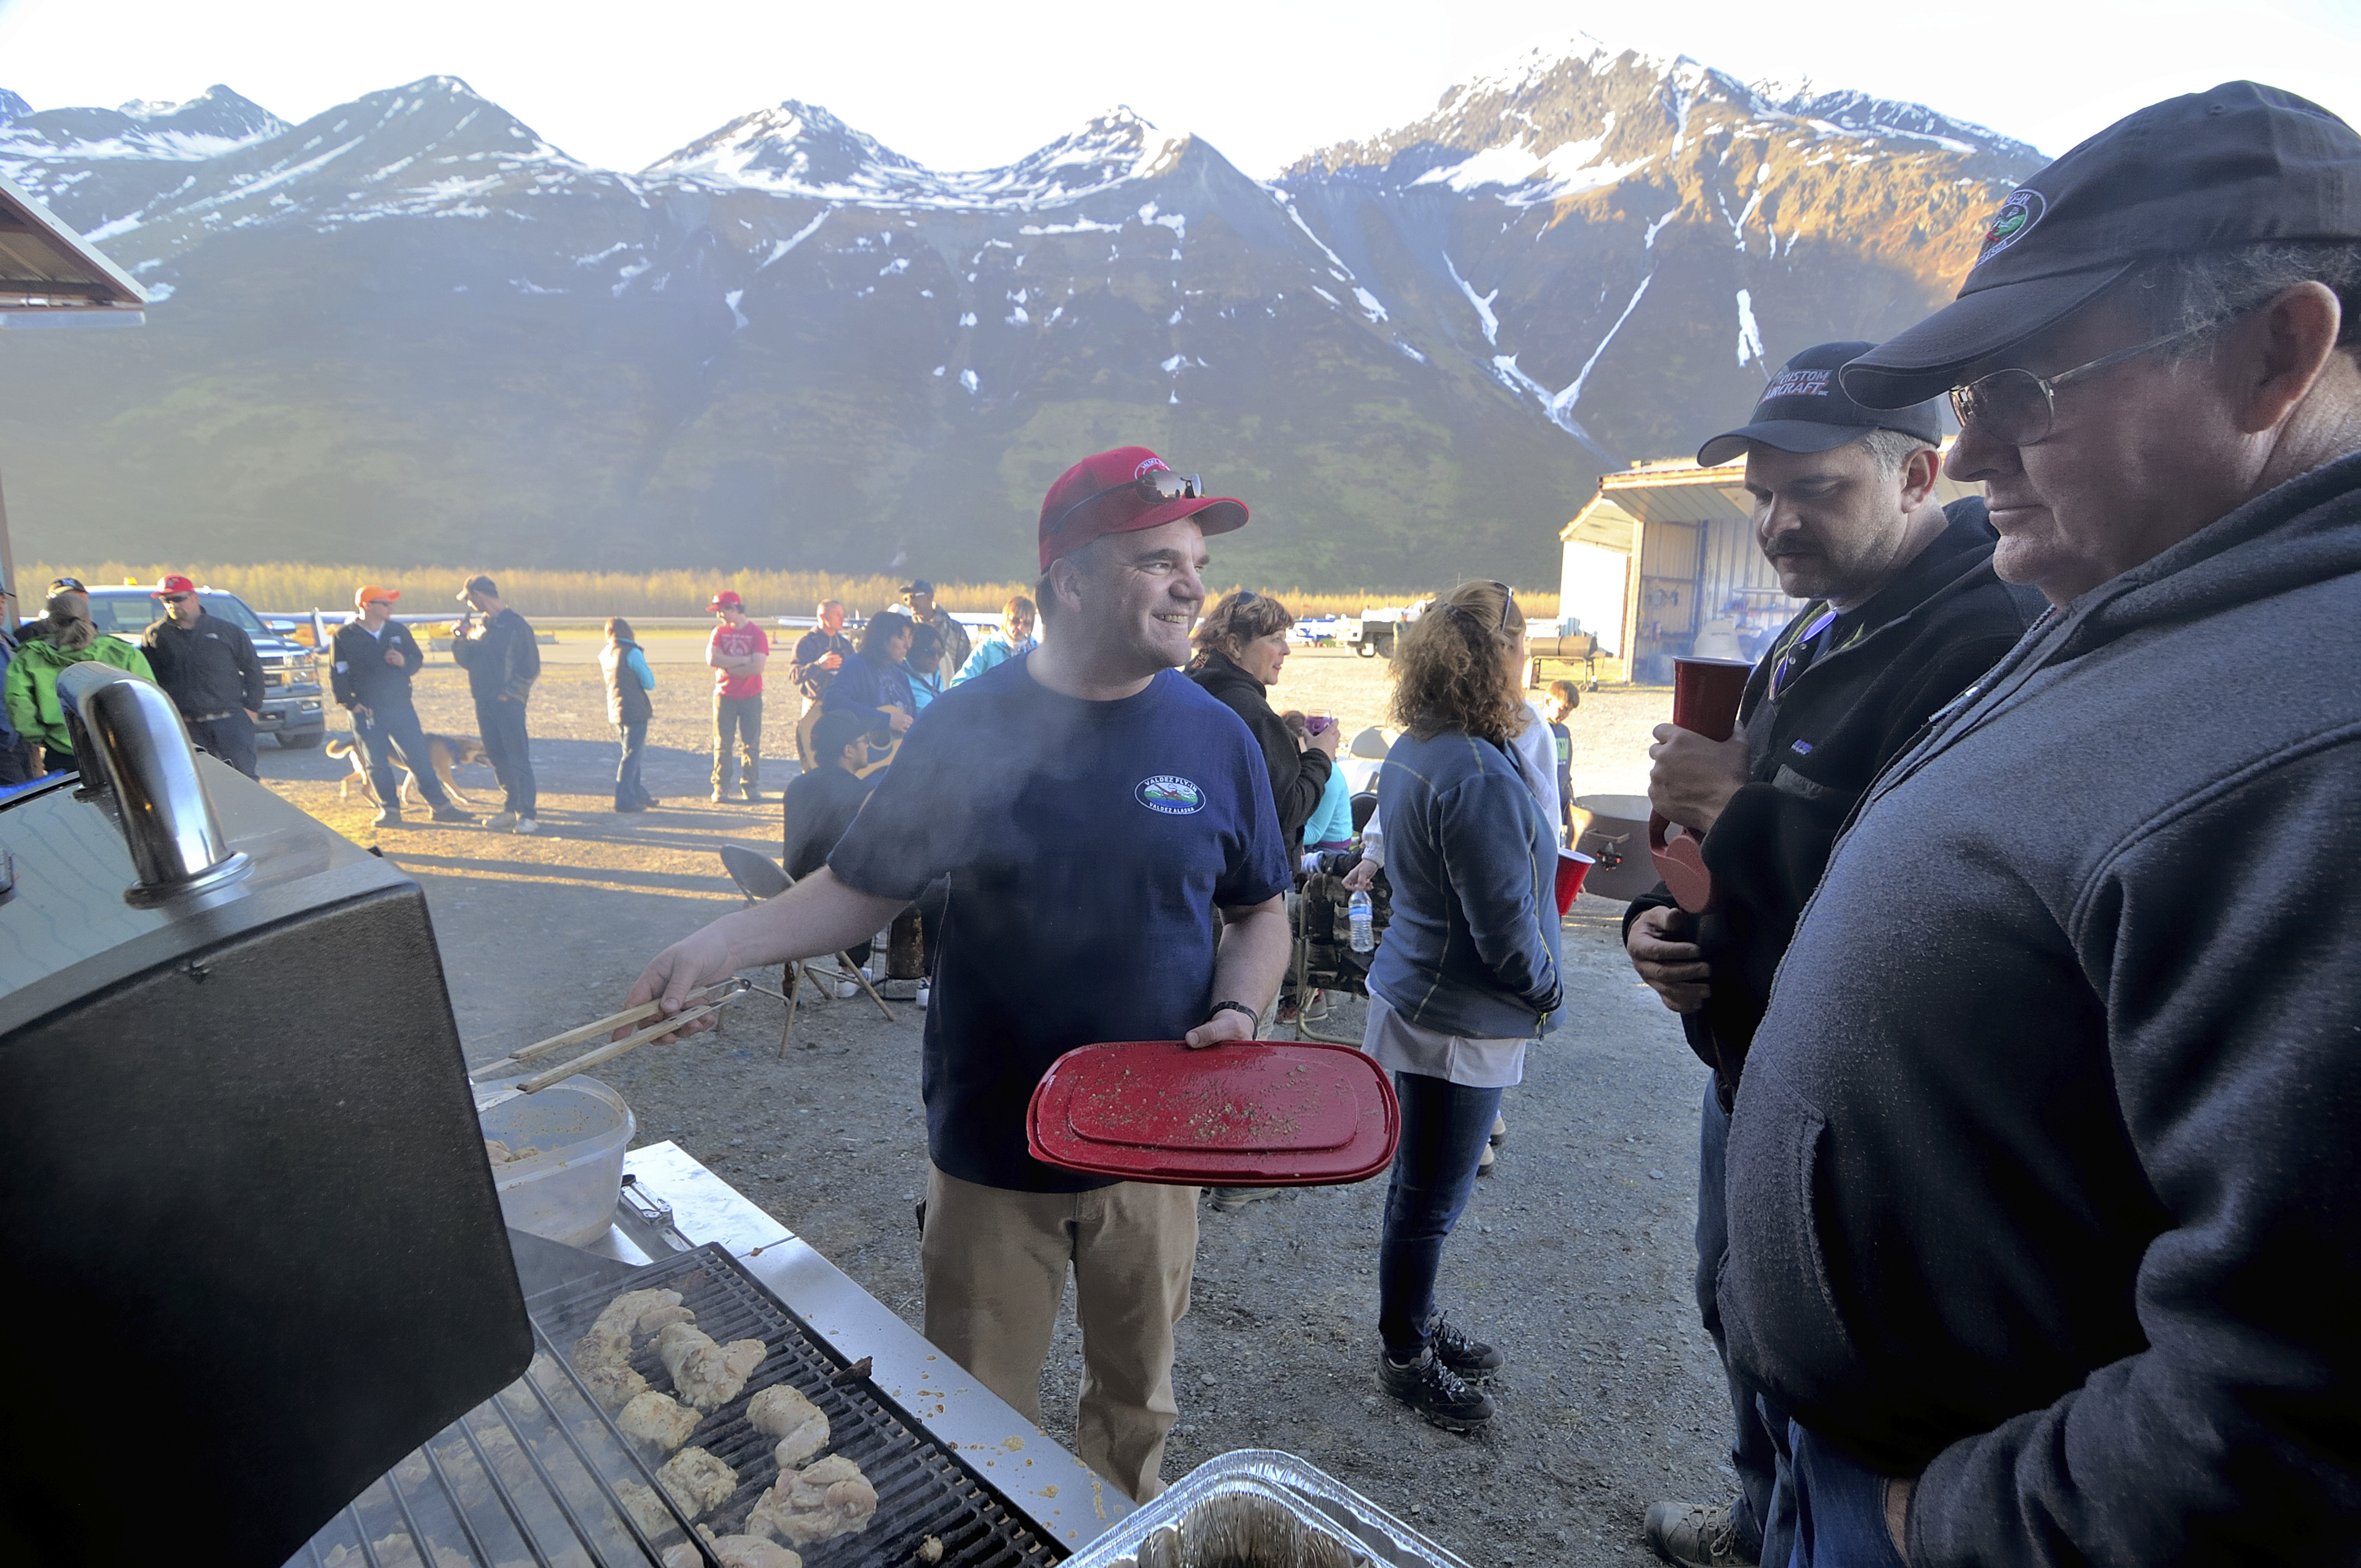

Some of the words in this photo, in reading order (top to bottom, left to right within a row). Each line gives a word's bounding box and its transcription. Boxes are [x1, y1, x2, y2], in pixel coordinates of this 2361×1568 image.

[1780, 370, 1831, 384] CUSTOM
[1762, 382, 1825, 402] AIRCRAFT
[1144, 777, 1173, 785] VALDEZ
[1175, 779, 1197, 792] FLY-IN
[1150, 802, 1171, 813] VALDEZ
